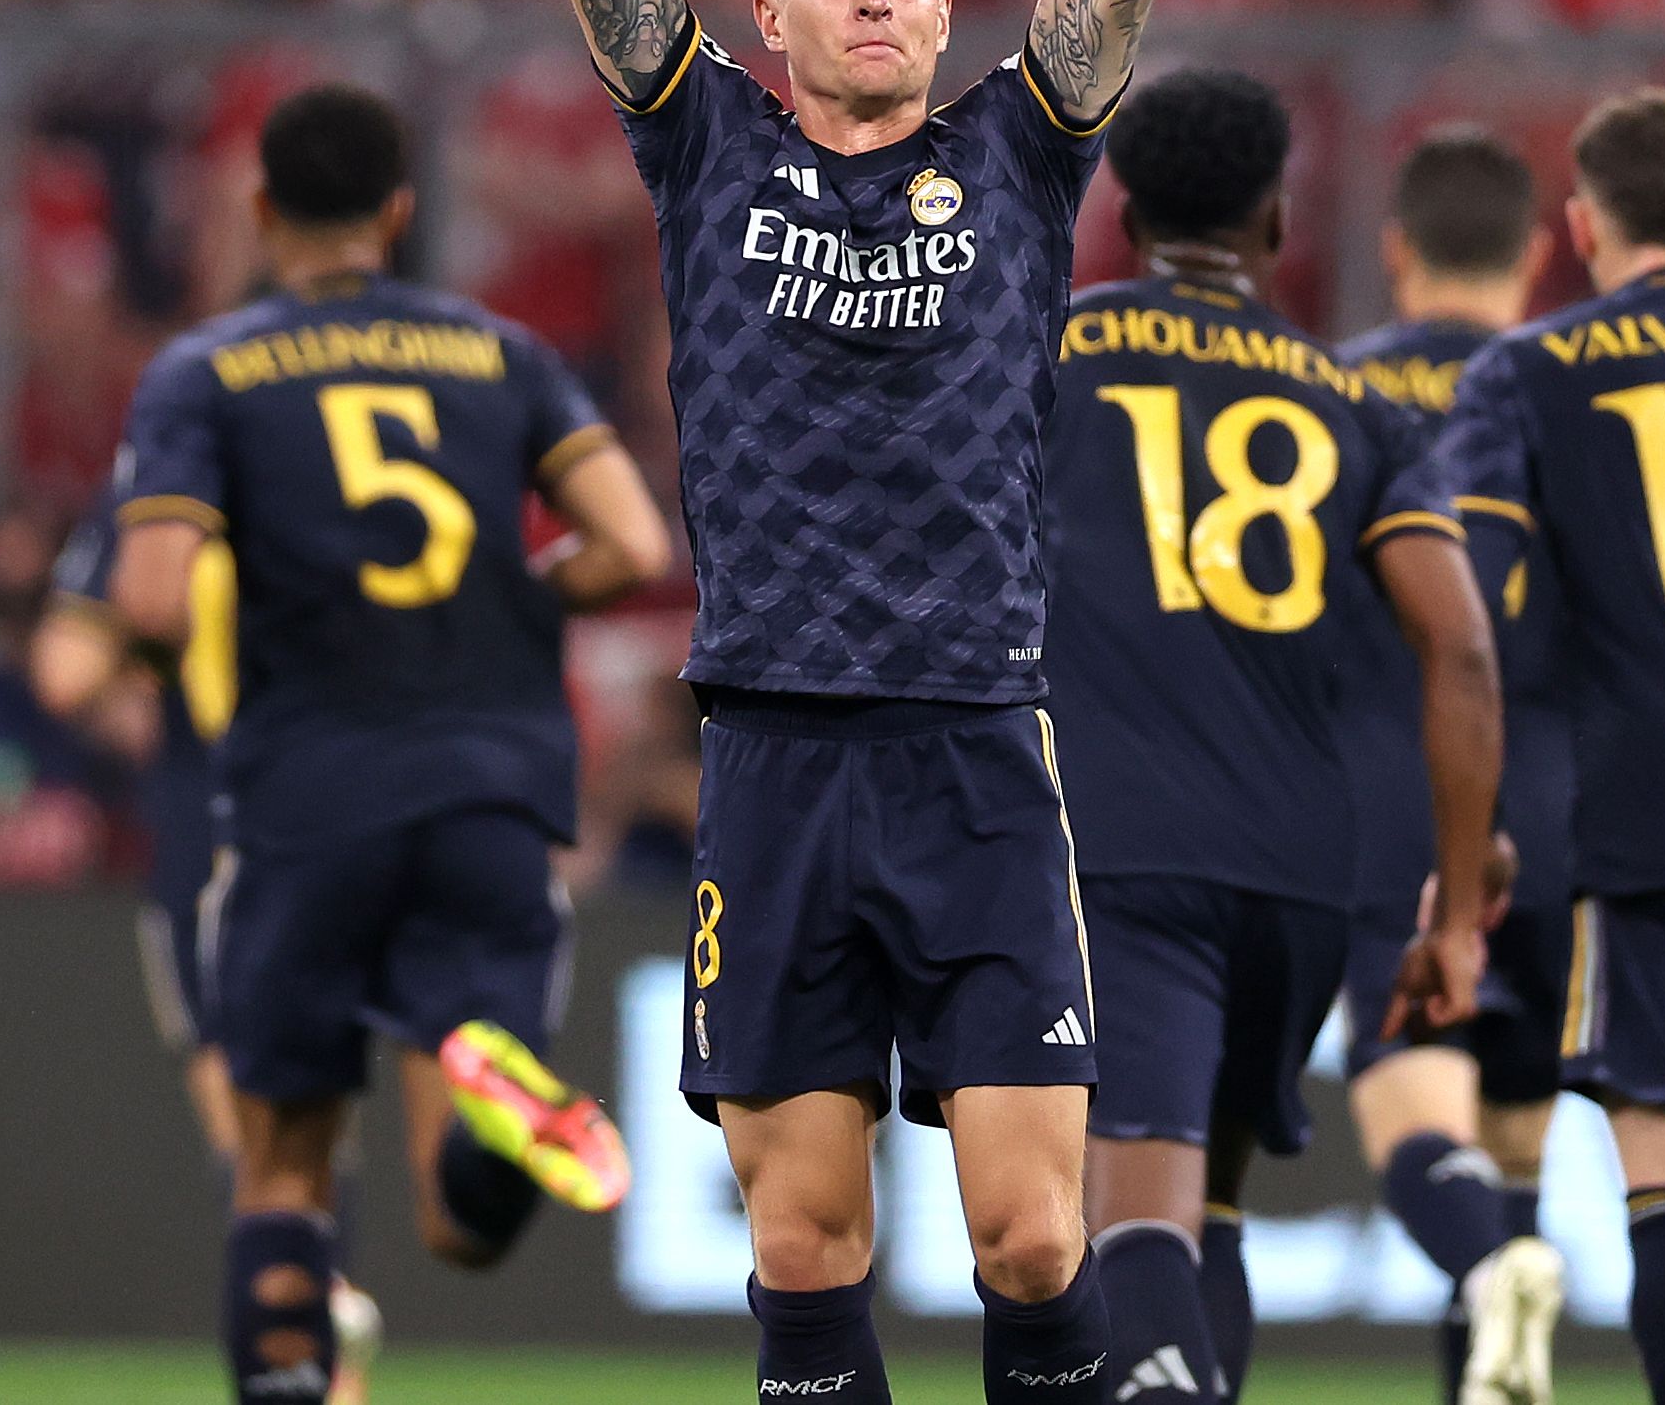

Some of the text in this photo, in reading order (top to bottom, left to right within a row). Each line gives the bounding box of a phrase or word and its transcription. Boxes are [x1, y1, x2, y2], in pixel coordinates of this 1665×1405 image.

[742, 207, 977, 284] Emirates
[766, 273, 945, 329] FLY BETTER
[317, 383, 477, 610] 5
[1095, 383, 1340, 634] 18
[694, 879, 724, 989] 8
[760, 1369, 856, 1396] RMCF
[1007, 1351, 1107, 1386] RMCF
